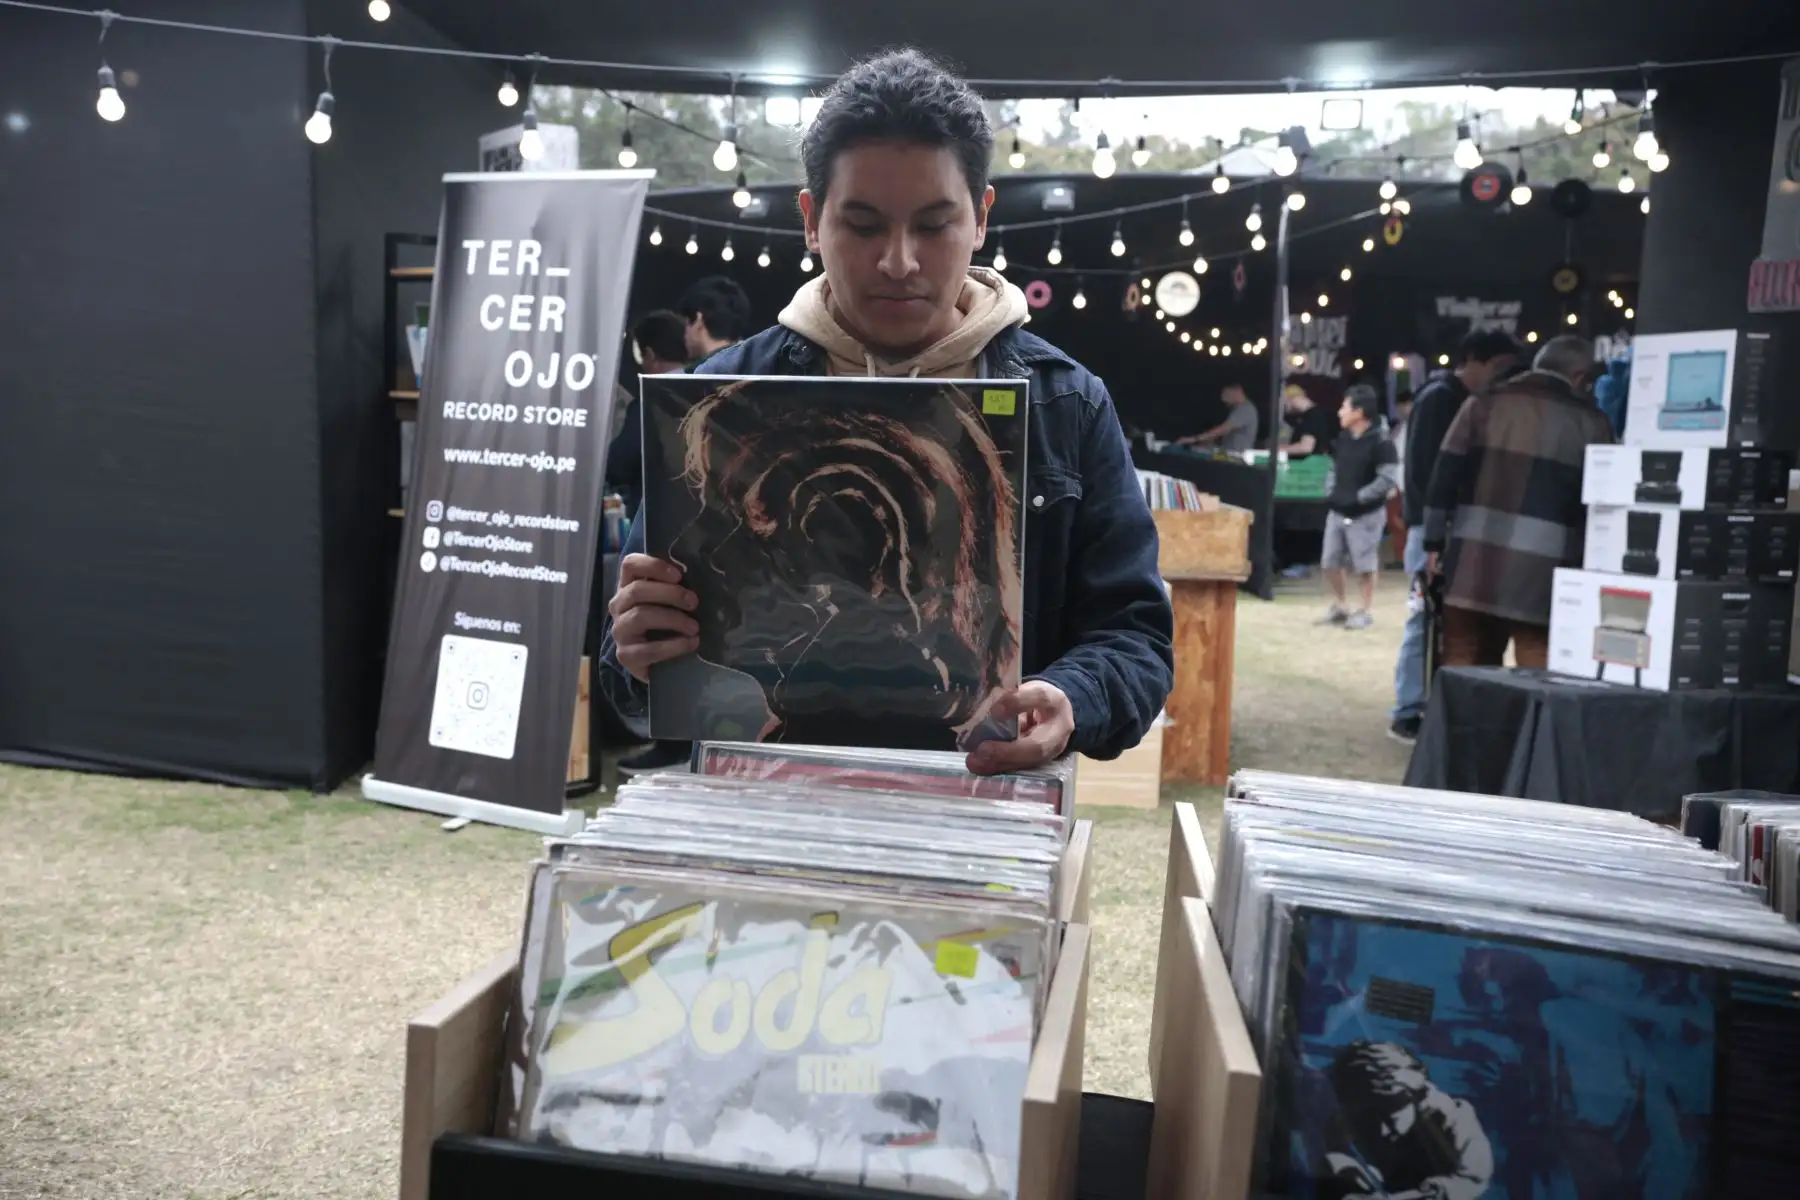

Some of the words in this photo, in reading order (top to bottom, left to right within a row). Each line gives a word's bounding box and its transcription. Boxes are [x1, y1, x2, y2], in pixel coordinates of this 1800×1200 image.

[480, 294, 566, 332] CER
[504, 350, 595, 391] OJO
[443, 401, 518, 422] RECORD
[523, 405, 588, 427] STORE
[444, 448, 577, 474] www.tercer-ojo.pe
[446, 506, 580, 532] @tercer_ojo_recordstore
[443, 530, 534, 553] @TercerOjoStore
[439, 555, 569, 583] @TercerOjoRecordStore
[543, 902, 894, 1076] Soda
